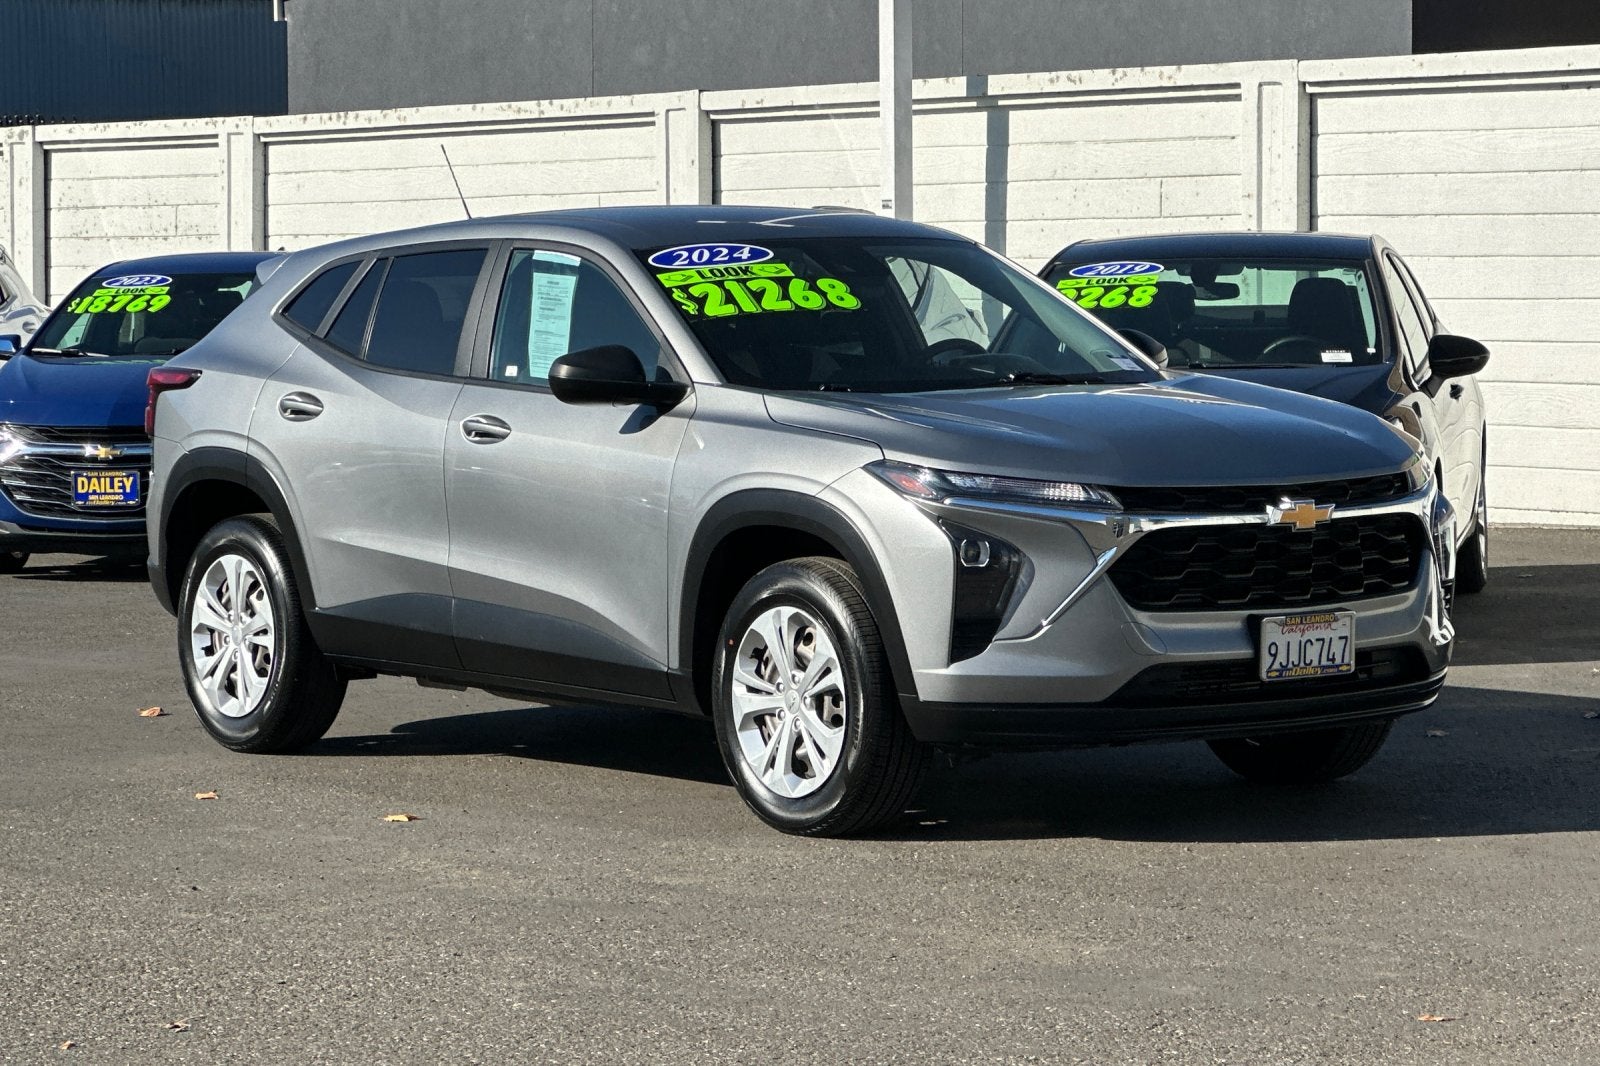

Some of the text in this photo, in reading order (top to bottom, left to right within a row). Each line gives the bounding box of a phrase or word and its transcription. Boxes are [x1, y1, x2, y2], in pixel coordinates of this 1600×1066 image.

[672, 246, 752, 266] 2024
[695, 265, 758, 280] LOOK
[1084, 264, 1150, 276] 2019
[112, 276, 161, 286] 2023
[1086, 277, 1129, 286] LOOK
[114, 287, 150, 295] LOOK
[671, 277, 862, 317] $21268
[66, 294, 172, 314] $18769
[77, 477, 133, 493] DAILEY
[1286, 614, 1334, 625] SAN LEANDRO
[1281, 623, 1337, 637] California
[1267, 636, 1348, 670] 9JJC747
